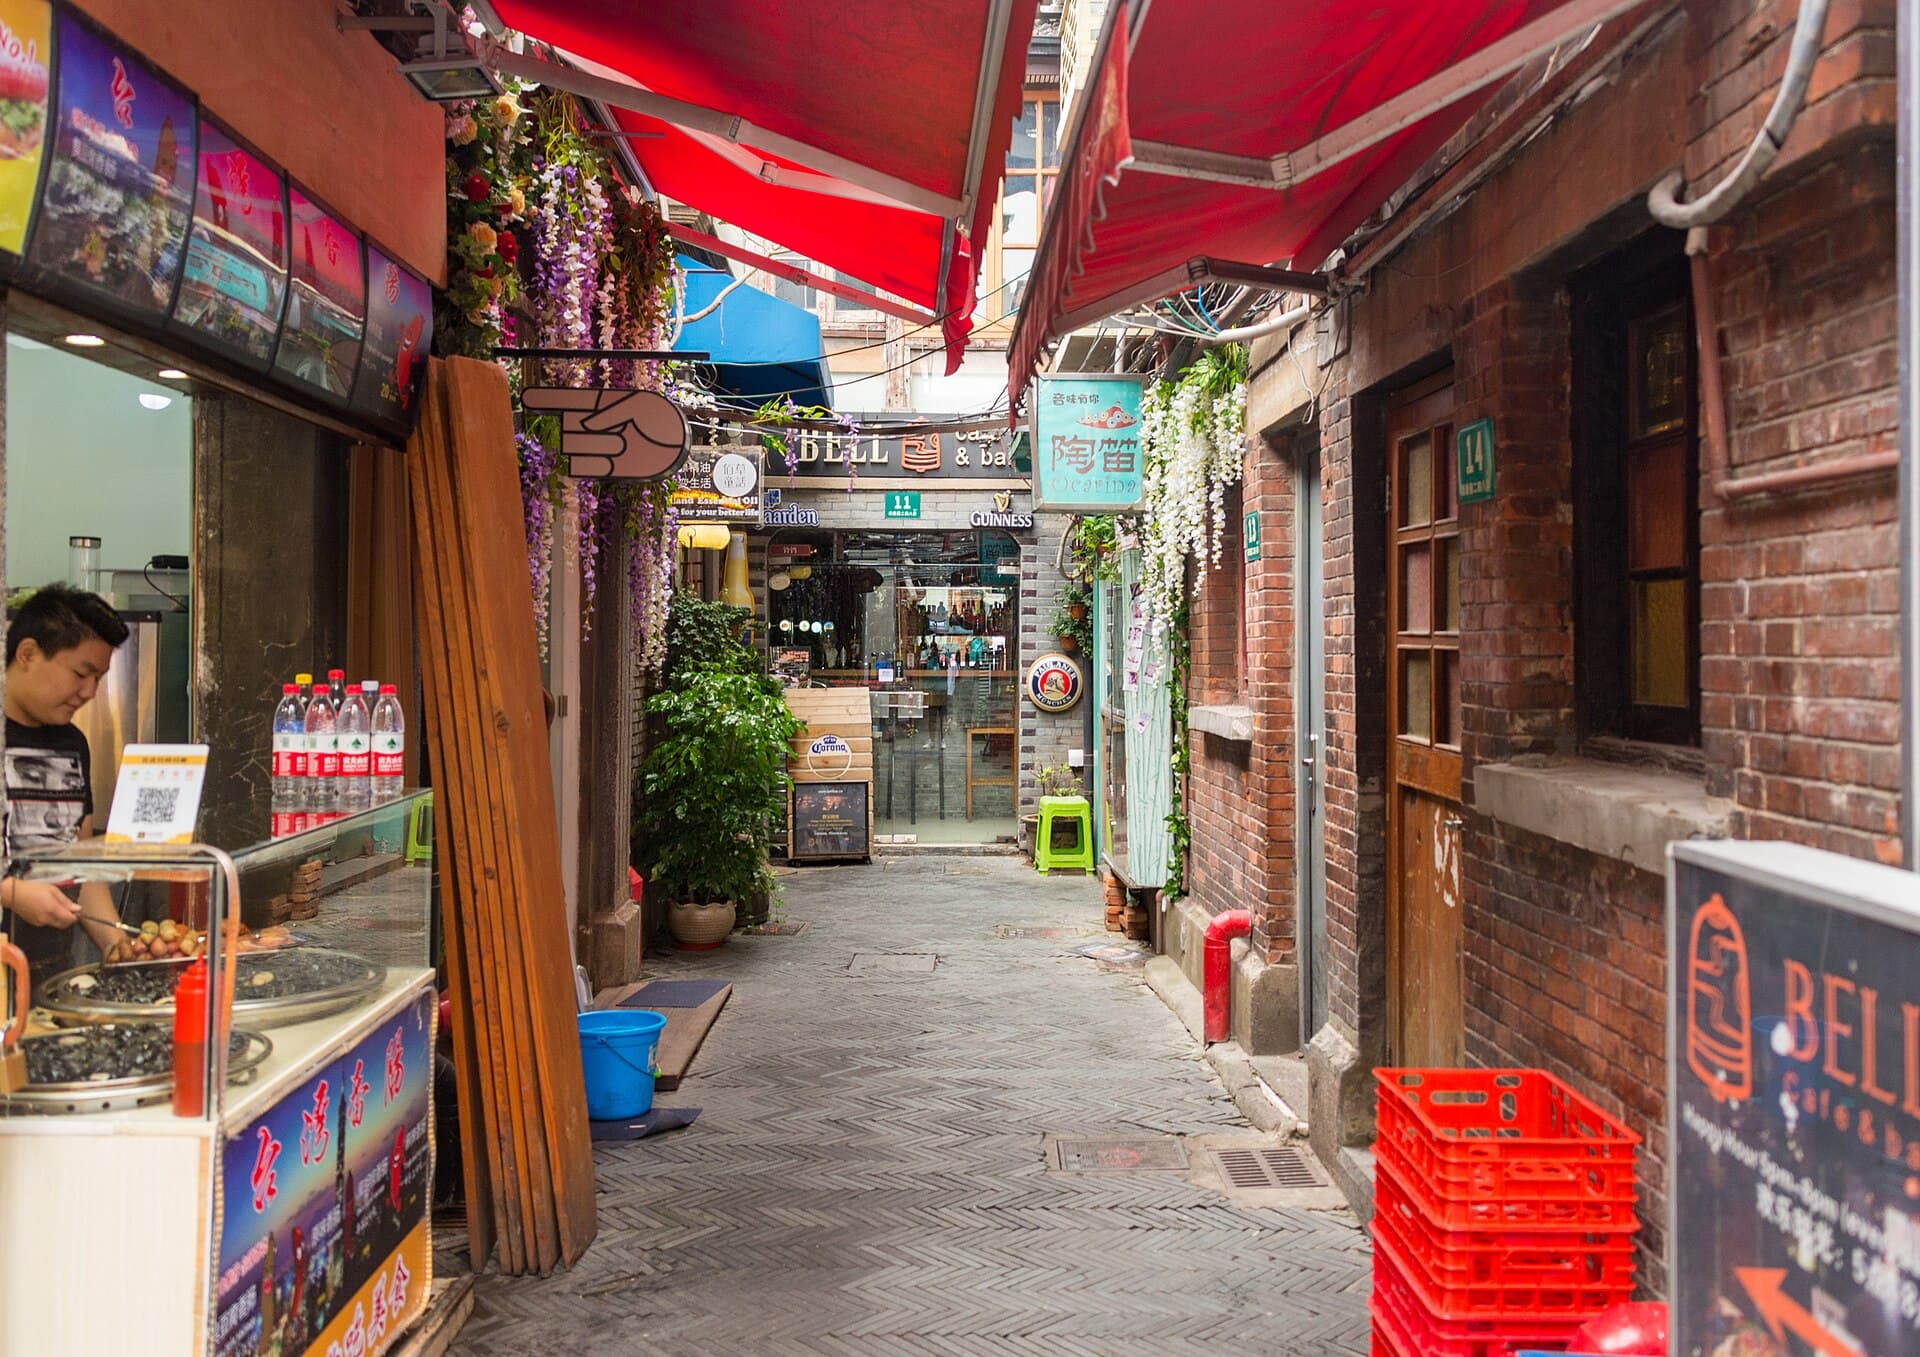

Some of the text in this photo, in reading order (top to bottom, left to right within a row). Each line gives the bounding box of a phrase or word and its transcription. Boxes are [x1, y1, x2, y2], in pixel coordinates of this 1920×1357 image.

[955, 446, 1012, 467] & ba
[1050, 434, 1138, 475] 陶笛
[1466, 431, 1484, 474] 14
[680, 508, 694, 516] for
[696, 508, 717, 517] your
[718, 508, 743, 516] better
[745, 508, 760, 516] life
[894, 495, 912, 510] 11
[763, 503, 819, 526] aarden
[970, 510, 1033, 528] GUINNESS
[811, 743, 848, 754] Corona
[1782, 957, 1920, 1122] BELL
[1884, 1122, 1920, 1172] ba
